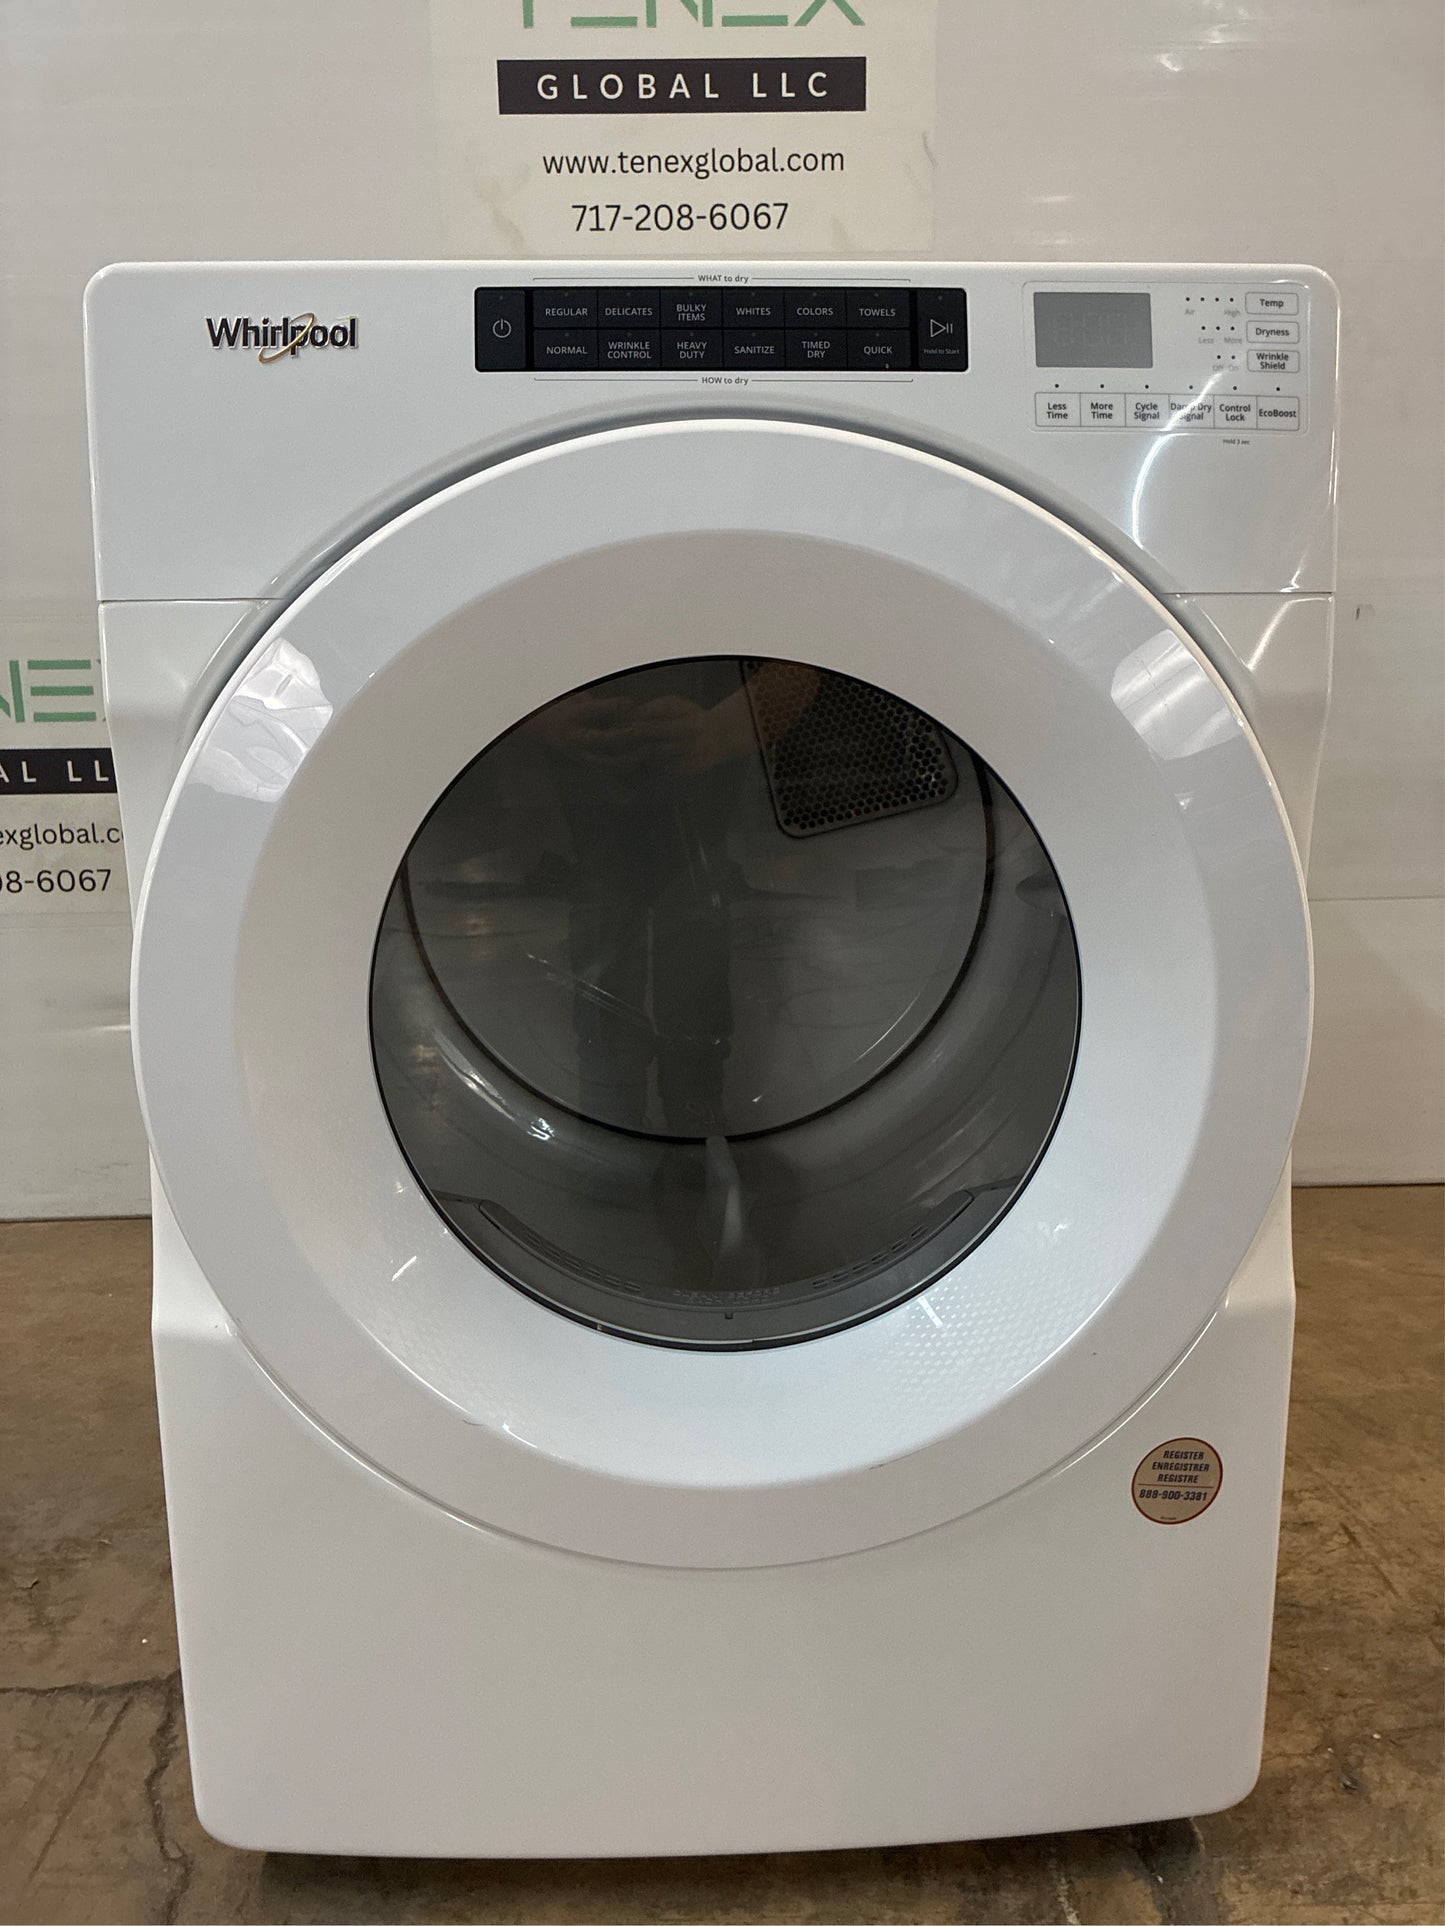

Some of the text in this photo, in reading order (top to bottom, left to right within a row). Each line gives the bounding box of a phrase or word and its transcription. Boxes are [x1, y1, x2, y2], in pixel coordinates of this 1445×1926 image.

[536, 71, 829, 101] GLOBAL LLC
[542, 147, 845, 179] www.tenexglobal.com
[571, 202, 789, 232] 717-208-6067
[697, 274, 722, 282] WHAT
[734, 274, 749, 284] dry
[676, 303, 707, 312] BULKY
[1259, 298, 1284, 309] Temp
[545, 307, 588, 316] REGULAR
[605, 307, 653, 316] DELICATES
[736, 307, 771, 316] WHITES
[796, 307, 834, 316] COLORS
[859, 308, 896, 317] TOWELS
[678, 313, 706, 321] ITEMS
[205, 315, 358, 358] Whirlpool
[1255, 327, 1290, 338] Dryness
[608, 341, 650, 350] WRINKLE
[677, 341, 707, 350] HEAVY
[734, 345, 775, 355] SANITIZE
[802, 341, 830, 350] TIMED
[546, 346, 587, 355] NORMAL
[607, 351, 652, 359] CONTROL
[679, 351, 705, 359] DUTY
[807, 350, 825, 359] DRY
[863, 346, 893, 356] QUICK
[1256, 352, 1289, 361] Wrinkle
[1260, 362, 1286, 370] Shield
[701, 376, 723, 384] HOW
[734, 376, 749, 386] dry
[1047, 402, 1067, 411] Less
[1090, 402, 1113, 411] More
[1135, 402, 1158, 412] Cycle
[1198, 402, 1212, 413] Dry
[1219, 403, 1251, 413] Control
[1046, 411, 1069, 420] Time
[1091, 411, 1113, 420] Time
[1134, 411, 1160, 421] Signal
[1225, 413, 1246, 422] Lock
[1258, 408, 1297, 418] EcoBoost
[0, 822, 123, 850] xglobal.c
[0, 868, 112, 893] 8-6067
[1163, 1450, 1204, 1460] REGISTER
[1152, 1461, 1210, 1472] ENREGISTRER
[1157, 1473, 1199, 1483] REGISTRE
[1139, 1488, 1208, 1501] 888-900-3381
